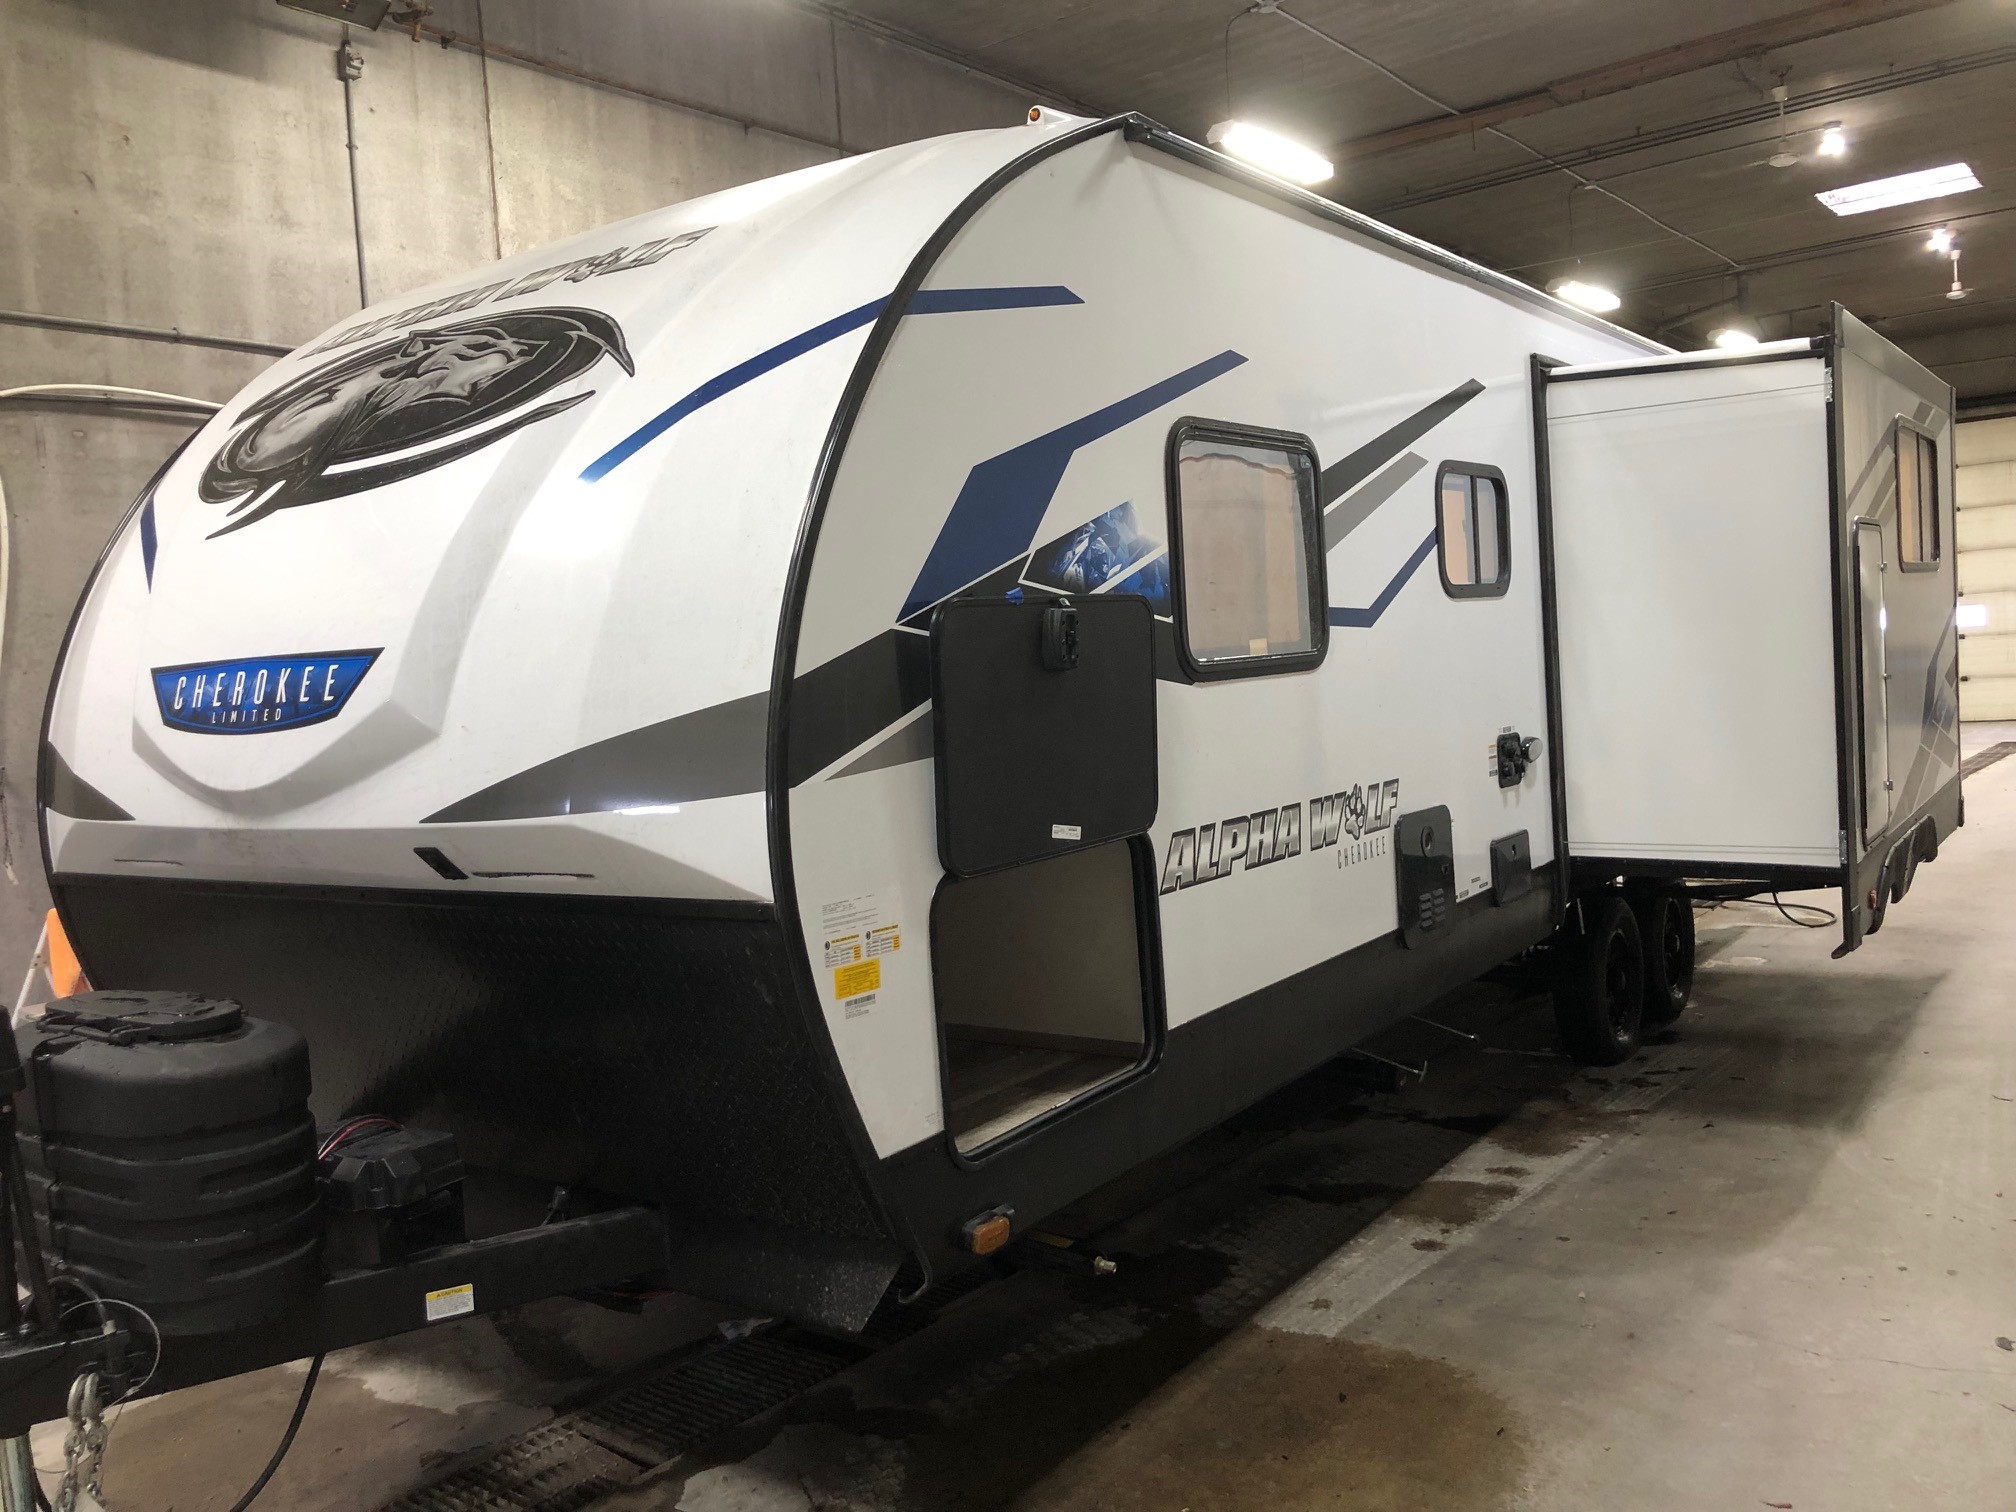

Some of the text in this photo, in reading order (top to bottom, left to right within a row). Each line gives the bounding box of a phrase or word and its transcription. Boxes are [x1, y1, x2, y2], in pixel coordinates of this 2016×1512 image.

[298, 278, 515, 360] ALPHA
[173, 664, 340, 710] CHEROKEE
[211, 708, 283, 724] LIMITED
[1159, 778, 1400, 896] ALPHA WOLF
[1337, 835, 1387, 870] CHEROKEE
[441, 1288, 463, 1297] CAUTION
